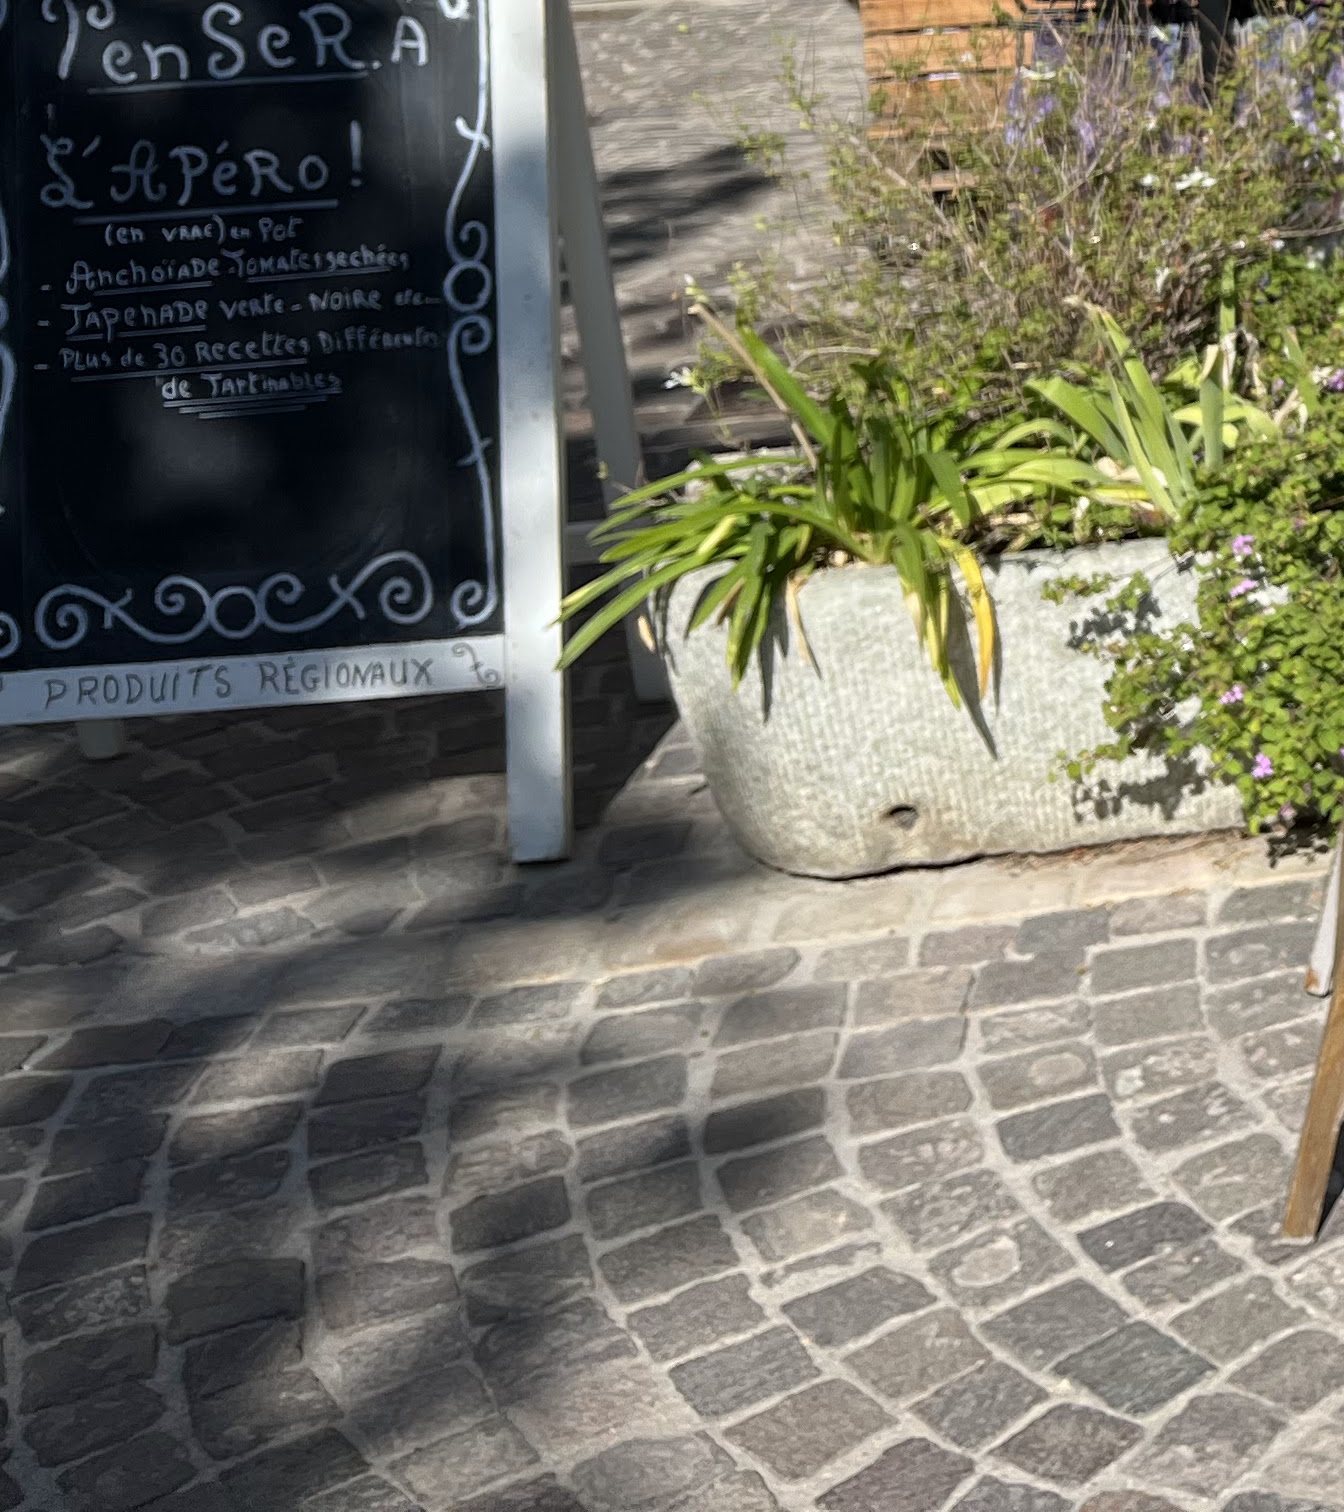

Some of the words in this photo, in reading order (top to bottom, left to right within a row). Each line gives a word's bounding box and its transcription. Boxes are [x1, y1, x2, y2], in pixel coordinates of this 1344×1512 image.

[152, 342, 185, 368] 30
[162, 376, 192, 399] de
[45, 663, 232, 709] PRODUITS
